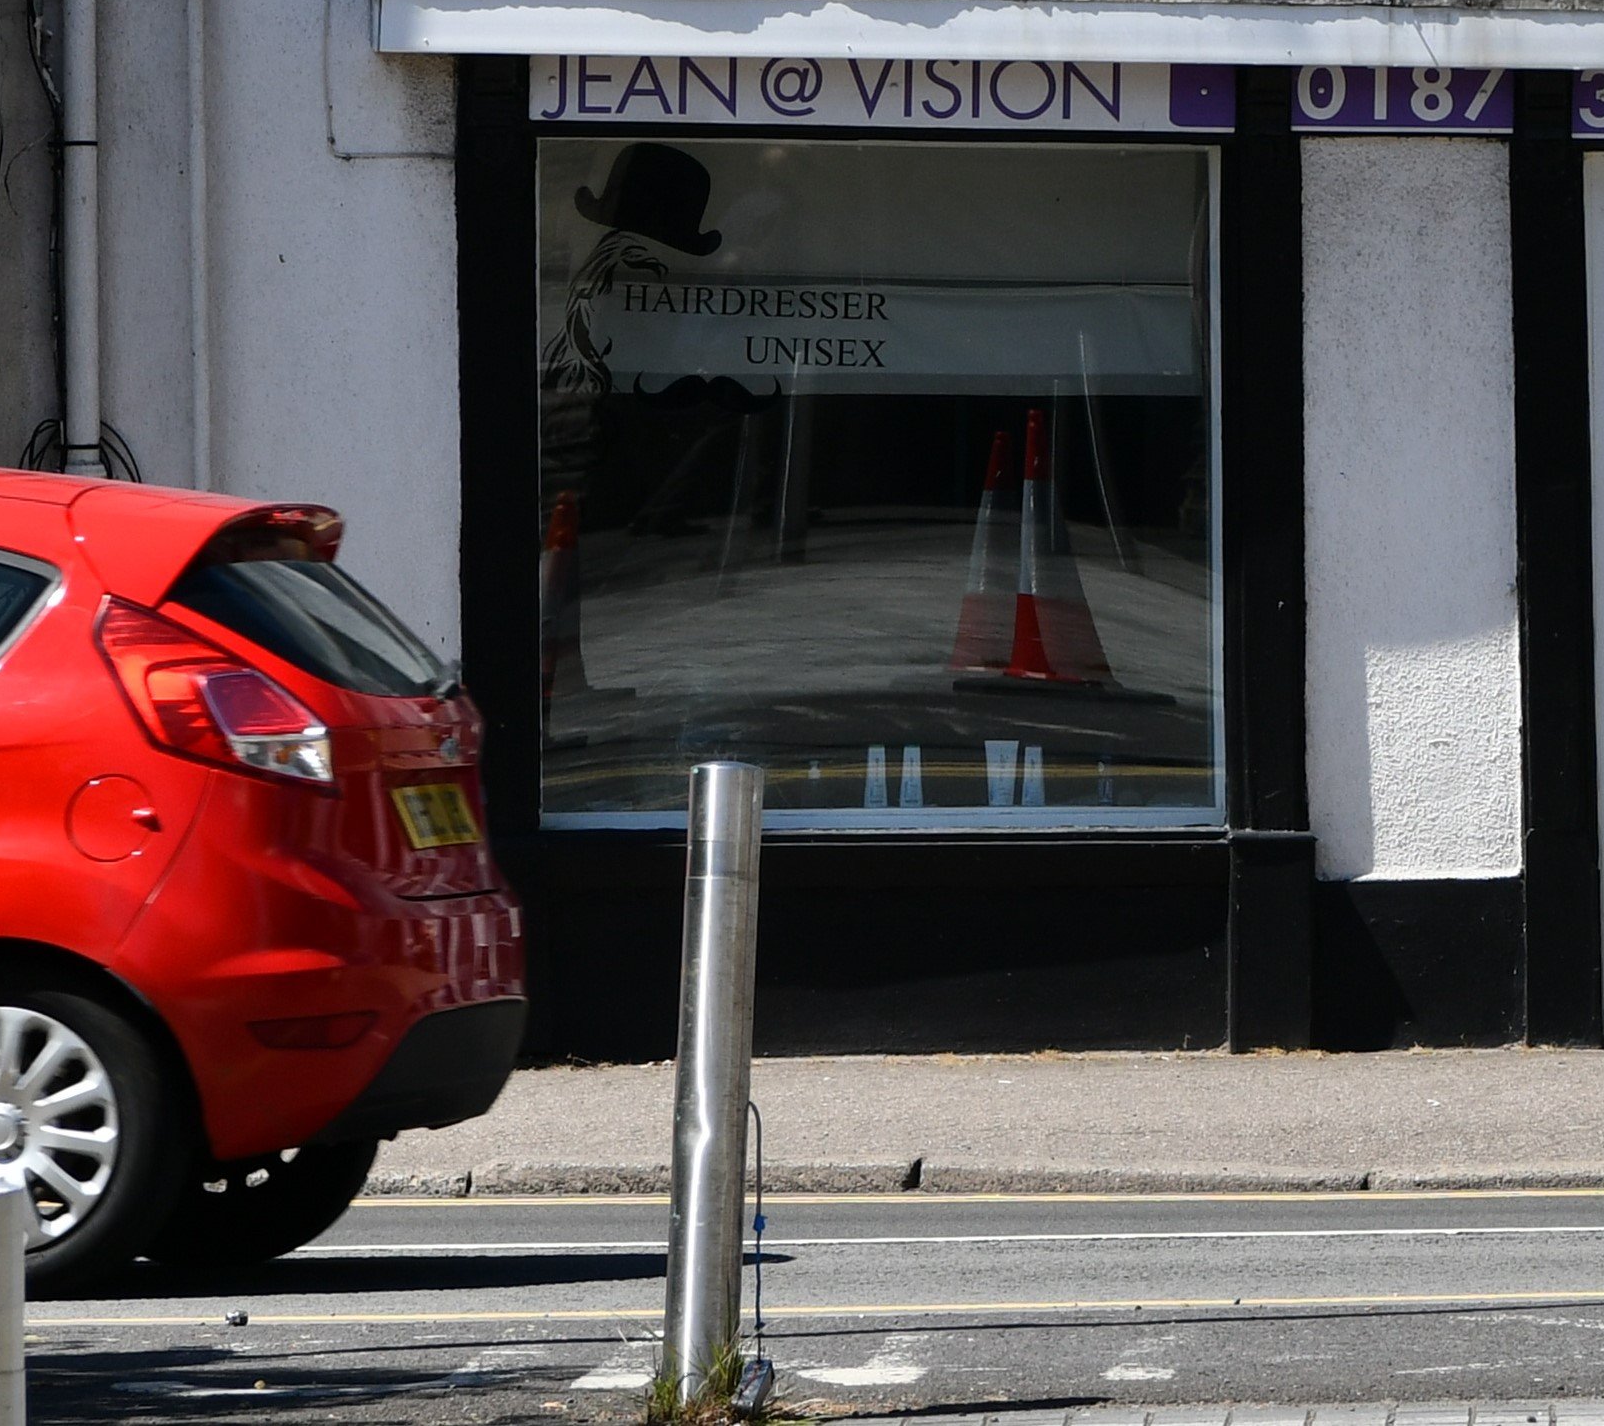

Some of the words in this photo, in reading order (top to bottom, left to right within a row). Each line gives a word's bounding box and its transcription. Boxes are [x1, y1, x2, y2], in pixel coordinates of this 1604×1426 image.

[541, 56, 737, 119] JEAN
[847, 59, 1122, 122] VISION
[1297, 66, 1506, 122] 0187
[623, 283, 889, 322] HAIRDRESSER
[745, 335, 886, 369] UNISEX
